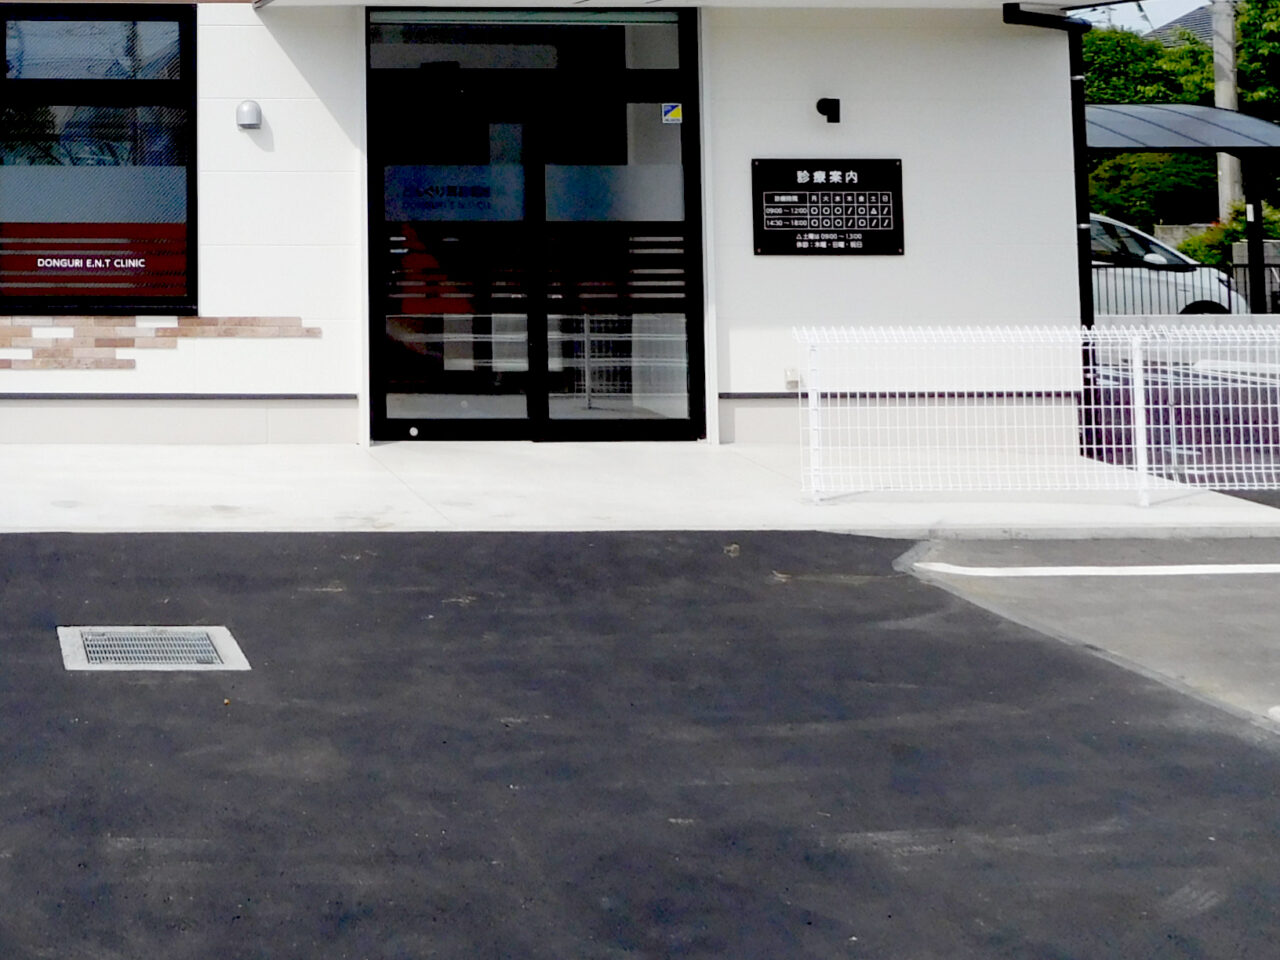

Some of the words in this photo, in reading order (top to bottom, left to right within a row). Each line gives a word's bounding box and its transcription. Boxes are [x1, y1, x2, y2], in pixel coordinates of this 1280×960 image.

[796, 170, 858, 183] 診療案内
[37, 258, 83, 268] DONGURI
[85, 258, 111, 268] E.N.T
[113, 258, 146, 268] CLINIC
